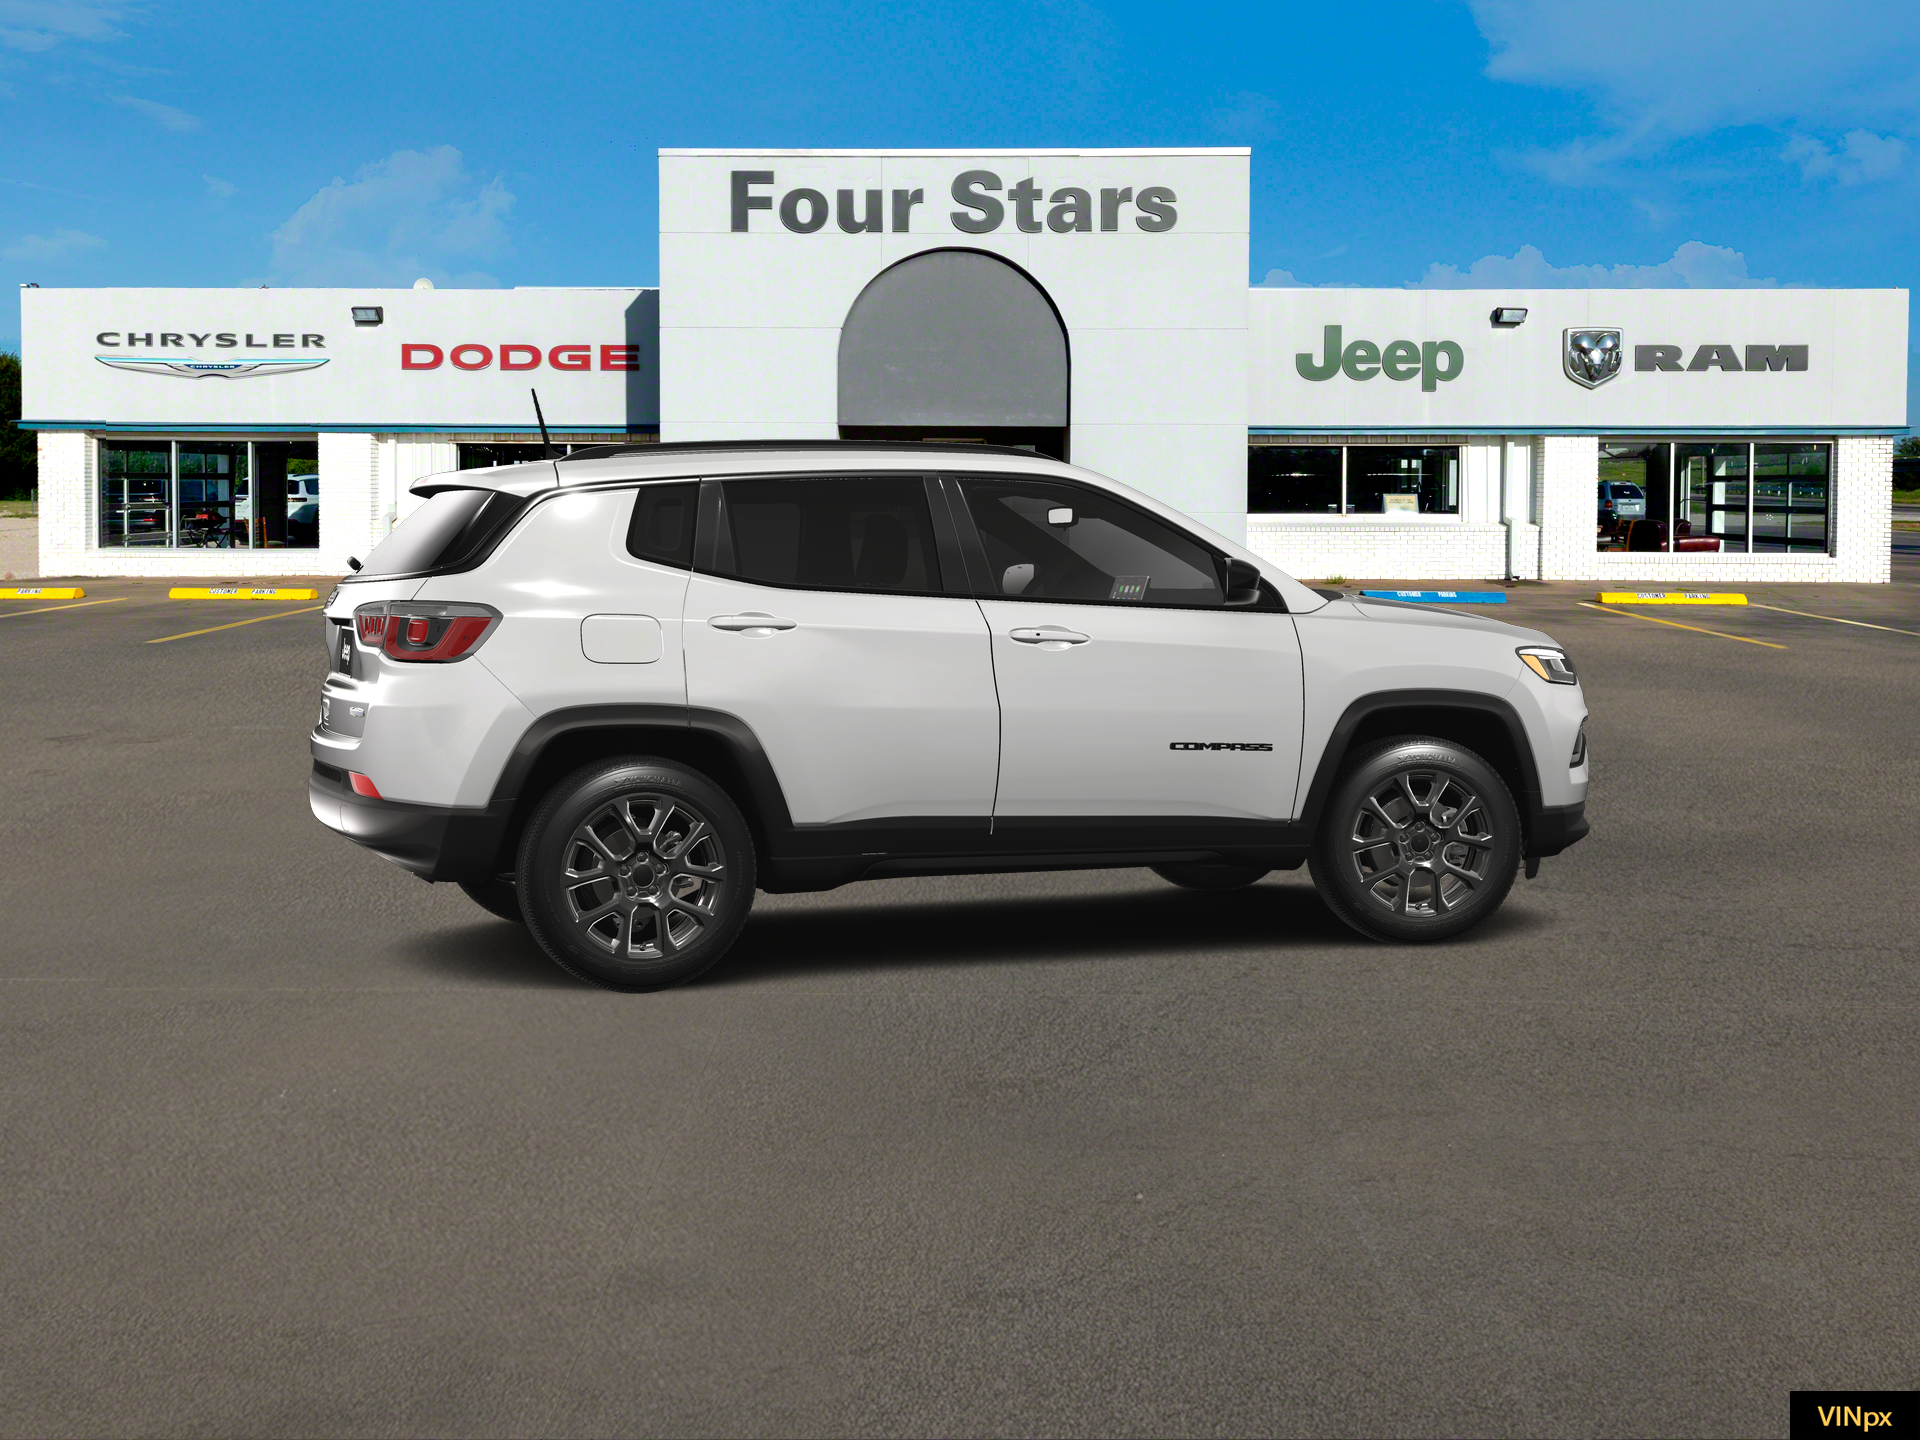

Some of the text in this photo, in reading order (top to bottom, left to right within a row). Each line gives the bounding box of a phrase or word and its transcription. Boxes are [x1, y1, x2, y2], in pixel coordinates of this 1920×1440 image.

[730, 169, 1179, 234] Four Stars
[96, 331, 327, 349] CHRYSLER
[401, 343, 640, 371] DODGE
[1295, 324, 1465, 392] Jeep
[1634, 344, 1809, 372] RAM
[1169, 742, 1273, 752] COMPASS
